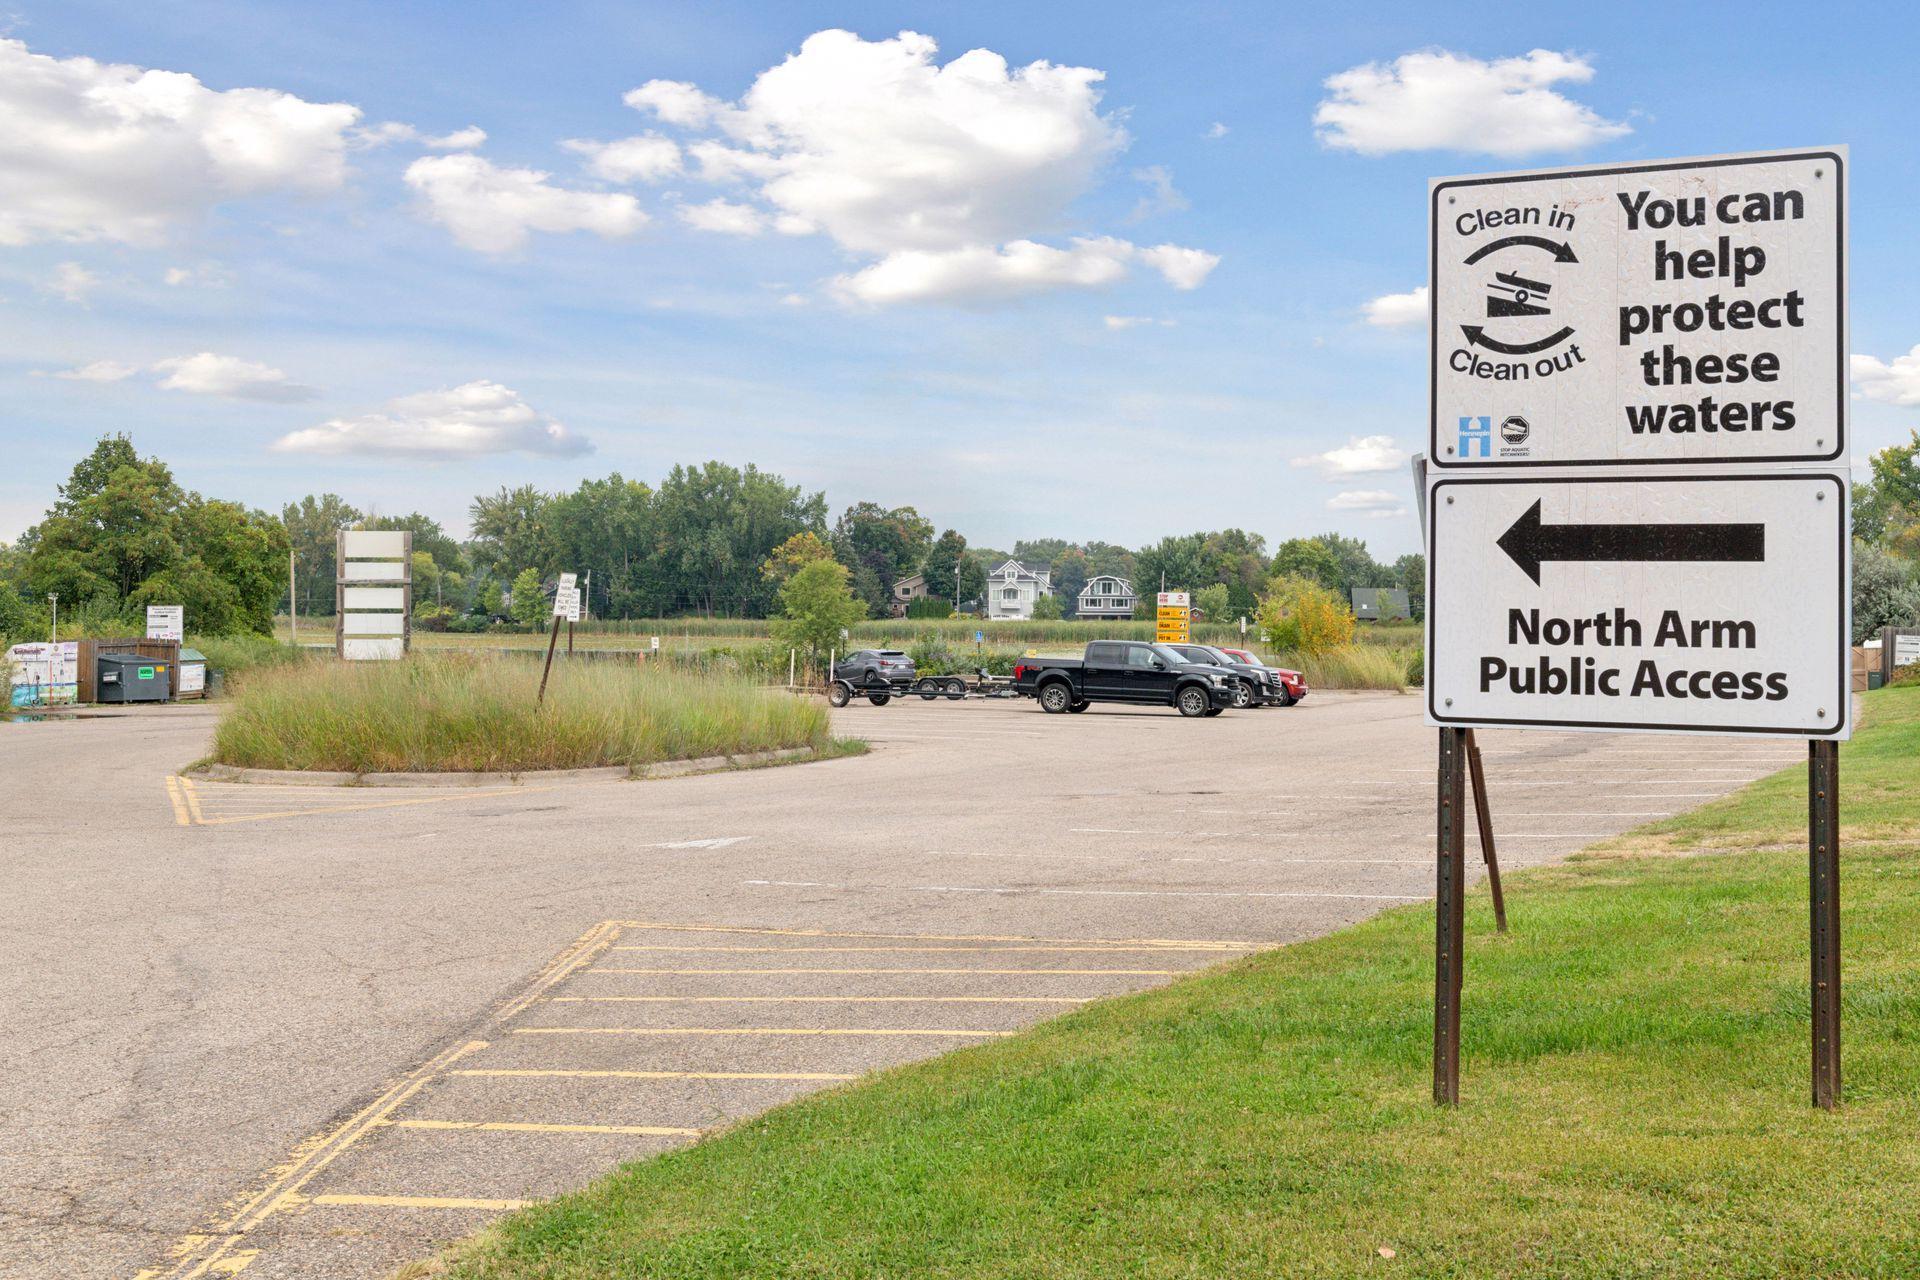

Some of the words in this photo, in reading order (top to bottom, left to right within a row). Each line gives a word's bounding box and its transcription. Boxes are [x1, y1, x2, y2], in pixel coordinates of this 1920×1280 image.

[1455, 207, 1541, 236] Clean
[1548, 204, 1576, 231] in
[1616, 190, 1706, 231] You
[1716, 190, 1804, 224] can
[1655, 235, 1766, 288] help
[1619, 289, 1804, 346] protect
[1449, 348, 1529, 381] Clean
[1534, 343, 1586, 377] out
[1640, 344, 1780, 386] these
[1625, 396, 1796, 434] waters
[1508, 607, 1642, 647] North
[1653, 610, 1756, 649] Arm
[1480, 655, 1620, 697] Public
[1630, 659, 1789, 701] Access
